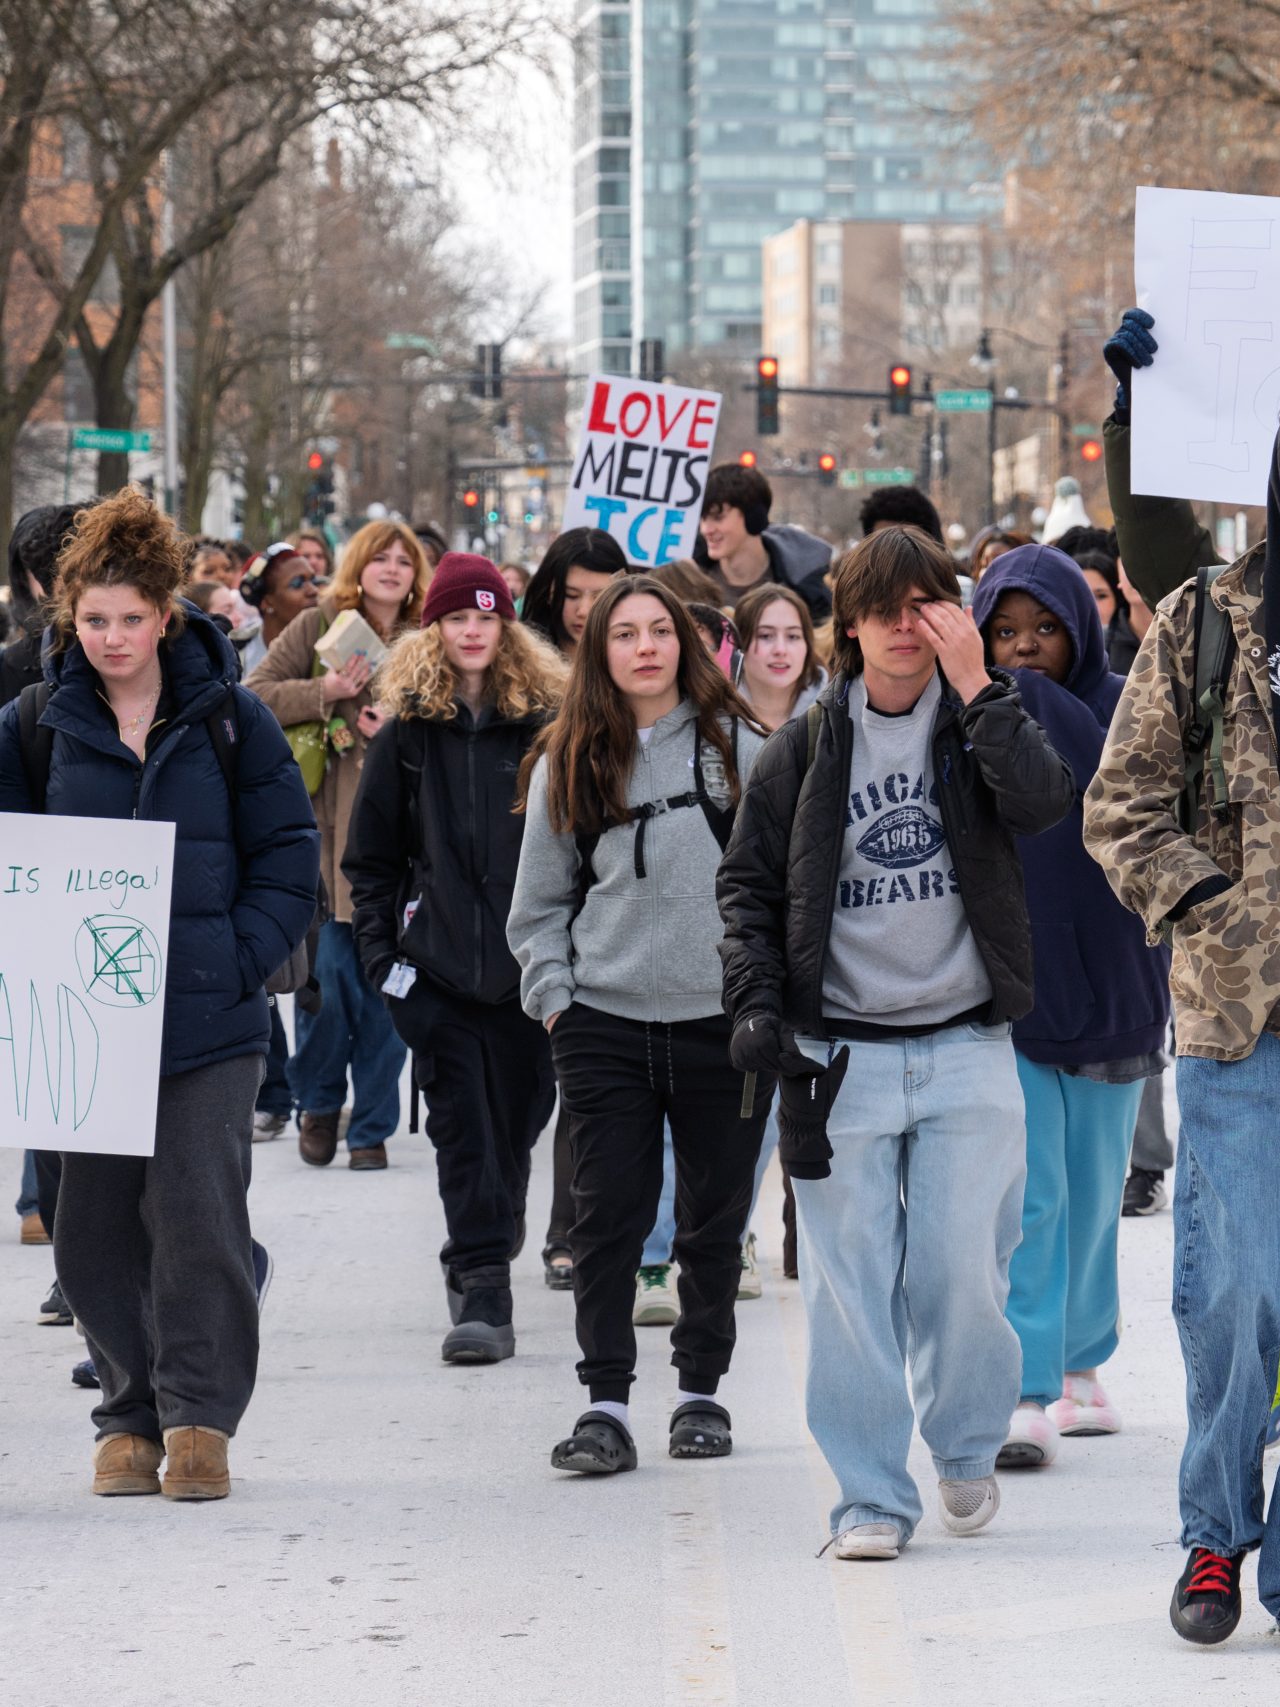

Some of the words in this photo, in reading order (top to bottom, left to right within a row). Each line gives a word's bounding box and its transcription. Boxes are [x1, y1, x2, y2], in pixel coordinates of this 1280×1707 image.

[587, 381, 716, 449] LOVE
[573, 438, 709, 508] MELTS
[584, 495, 686, 567] ICE
[876, 824, 932, 853] 1965
[3, 866, 40, 894] IS
